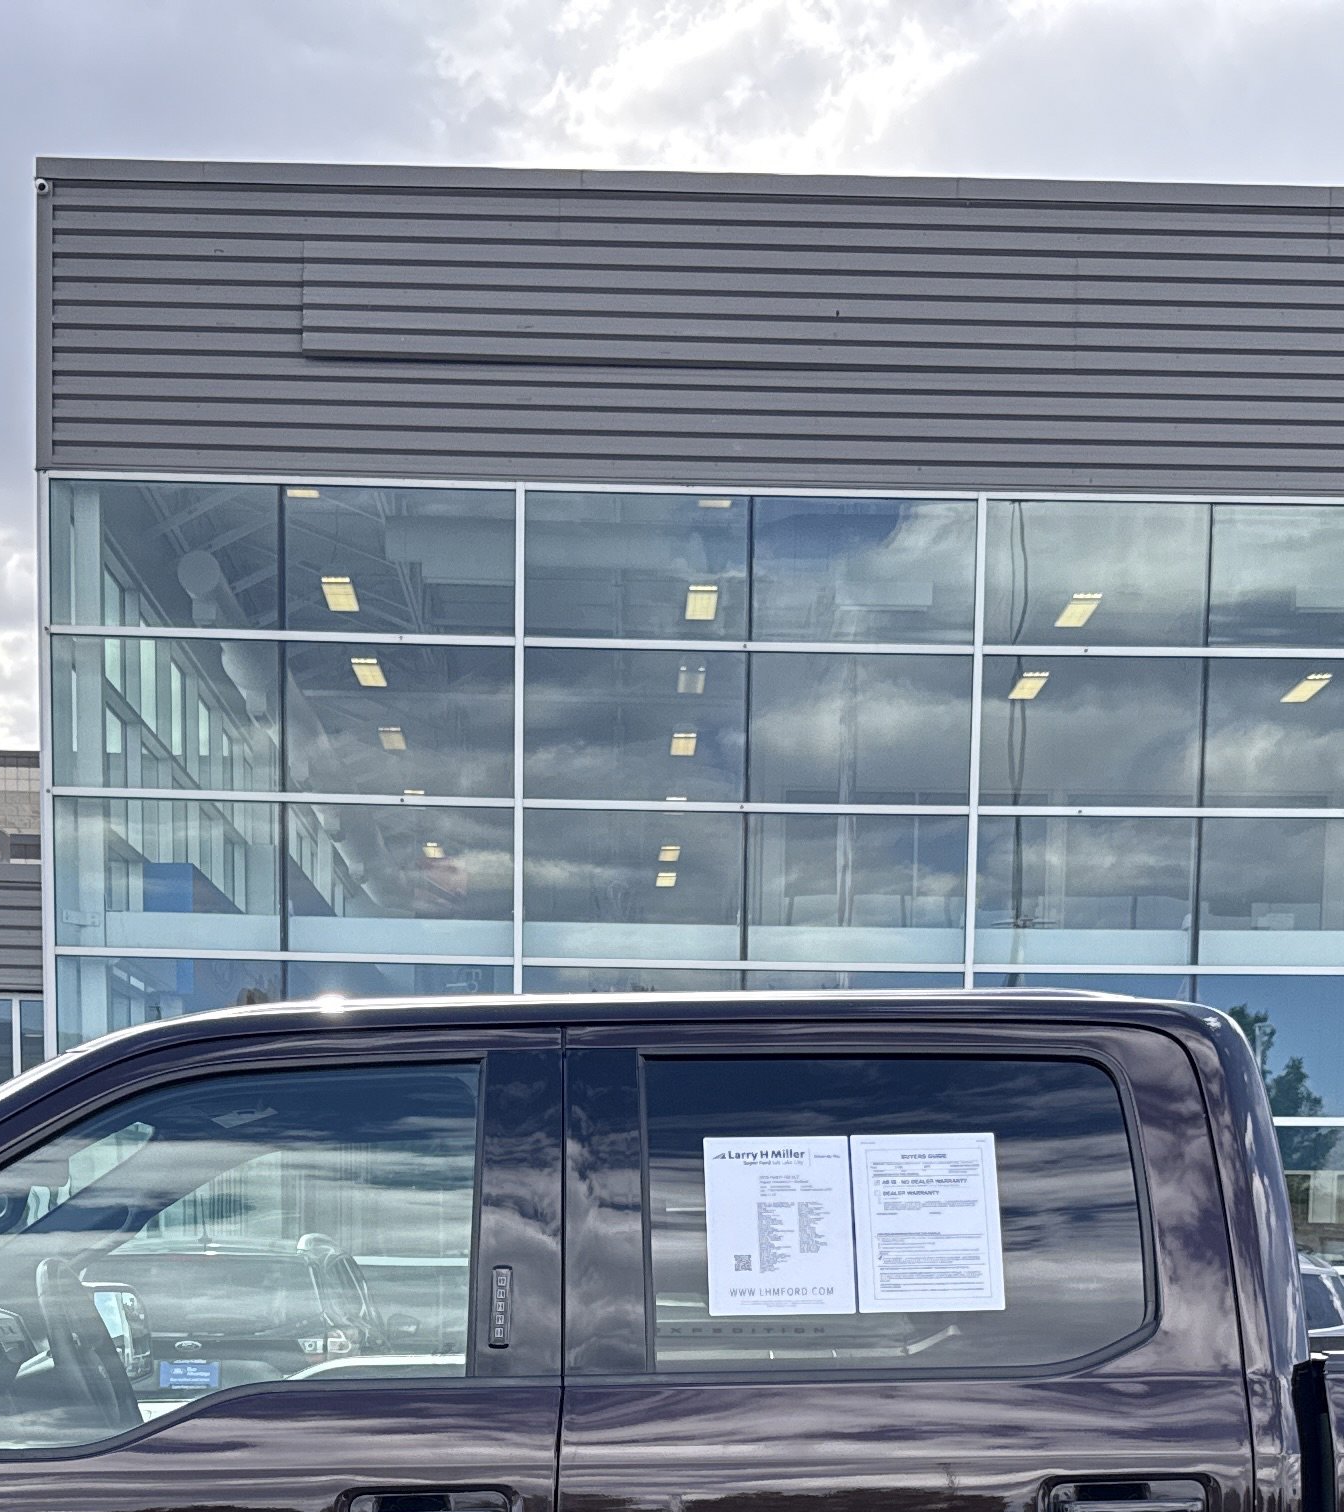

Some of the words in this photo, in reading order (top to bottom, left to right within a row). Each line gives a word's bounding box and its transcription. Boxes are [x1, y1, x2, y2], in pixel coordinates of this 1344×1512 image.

[728, 1150, 758, 1161] Larry
[760, 1150, 768, 1159] H
[771, 1149, 805, 1158] Miller
